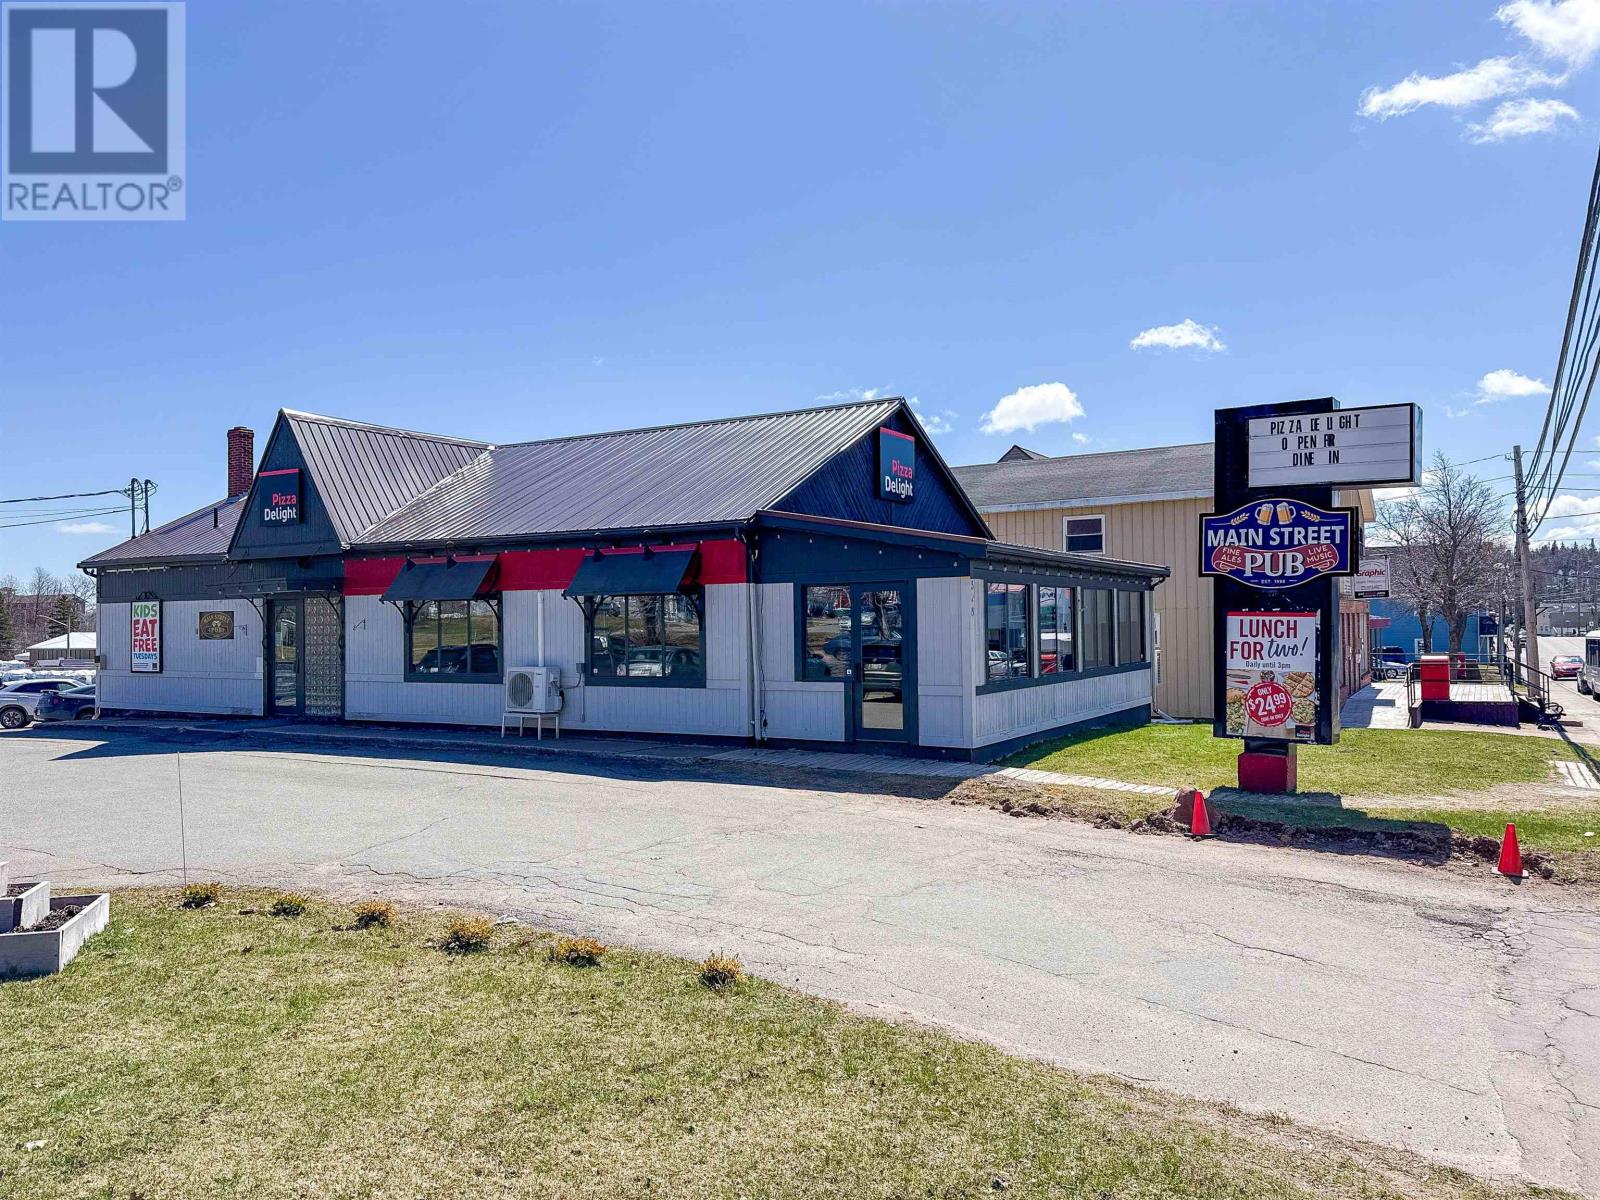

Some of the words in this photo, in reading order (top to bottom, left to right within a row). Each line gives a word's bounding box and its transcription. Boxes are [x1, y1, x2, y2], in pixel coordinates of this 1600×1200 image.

[1292, 451, 1315, 467] DINE
[1328, 450, 1340, 464] IN
[892, 459, 913, 479] Pizza
[885, 475, 913, 499] Delight
[272, 493, 297, 505] Pizza
[264, 506, 297, 522] Delight
[1207, 528, 1263, 547] MAIN
[1269, 525, 1345, 546] STREET
[1222, 546, 1241, 556] FINE
[1306, 552, 1333, 564] MUSIC
[1308, 545, 1329, 555] LIVE
[1220, 554, 1242, 564] ALES
[1243, 552, 1305, 577] PUB
[133, 603, 158, 618] KIDS
[133, 618, 158, 638] EAT
[1239, 619, 1298, 639] LUNCH
[133, 637, 158, 653] FREE
[1229, 640, 1264, 660] FOR
[1267, 636, 1309, 659] two!
[133, 652, 158, 660] TUESDAYS
[1245, 661, 1261, 669] Daily
[1277, 662, 1291, 670] 3pm
[1257, 686, 1272, 696] ONLY
